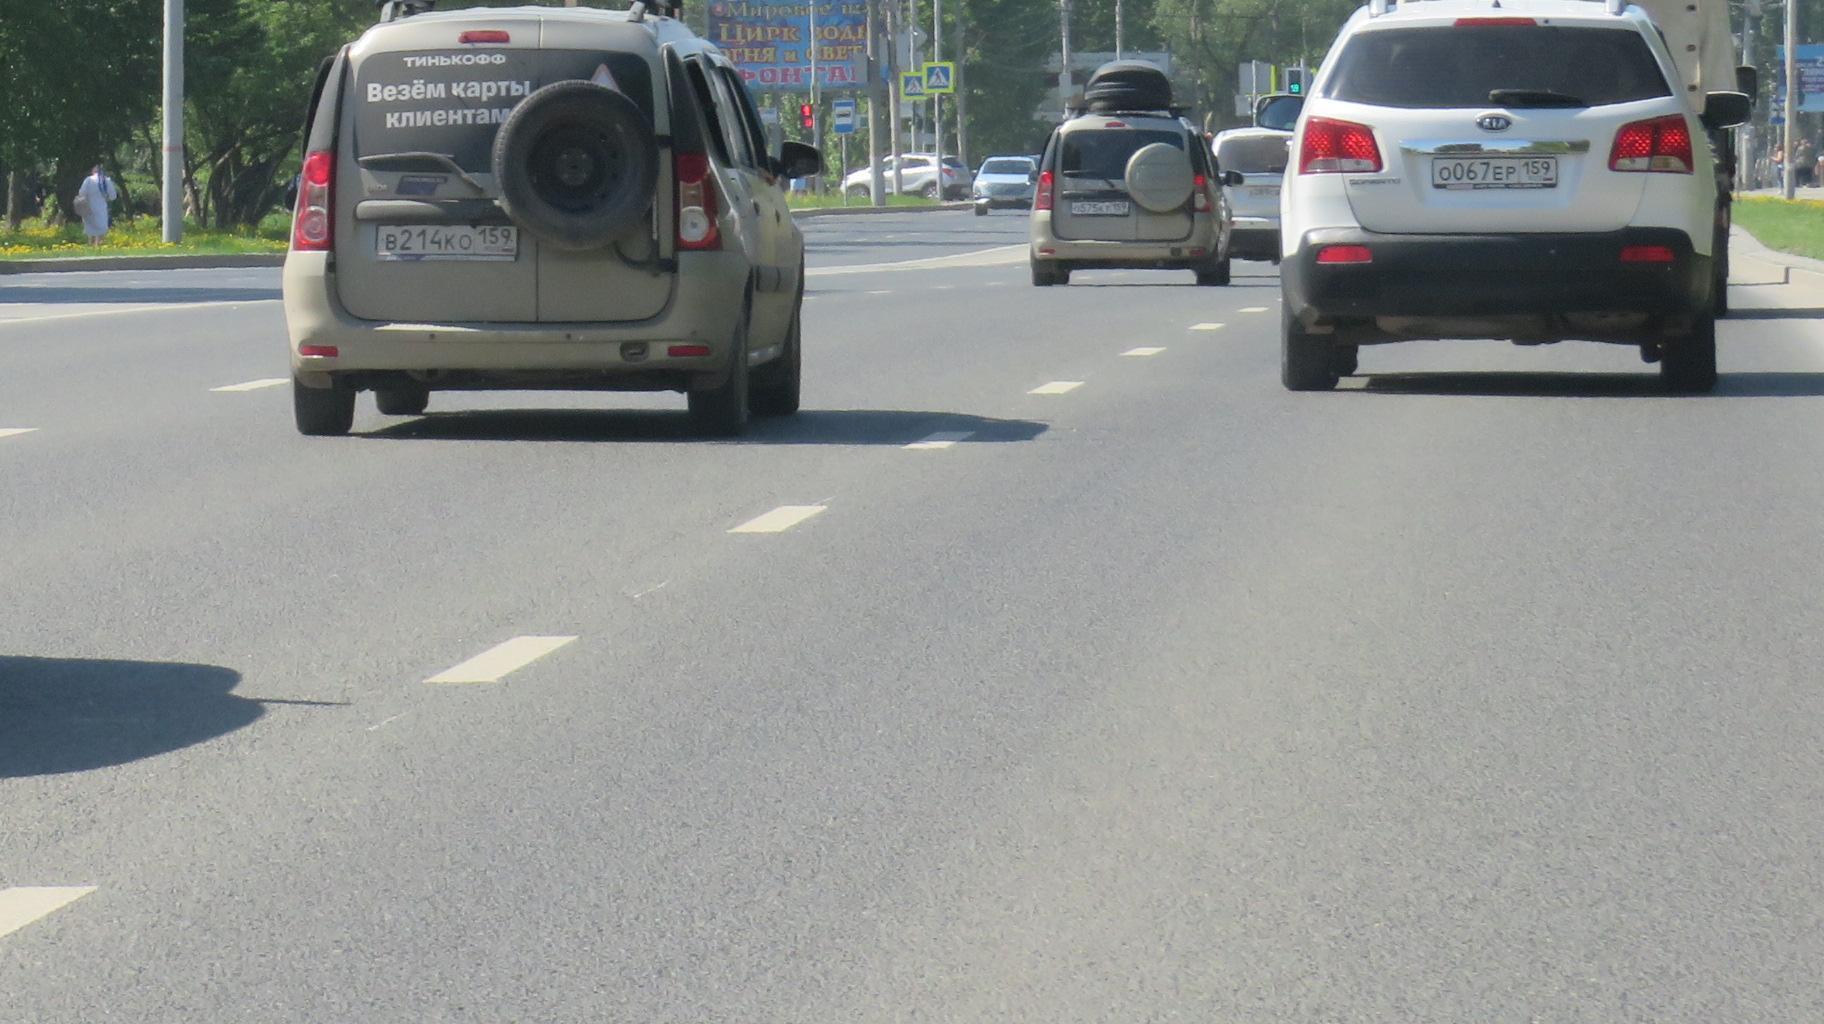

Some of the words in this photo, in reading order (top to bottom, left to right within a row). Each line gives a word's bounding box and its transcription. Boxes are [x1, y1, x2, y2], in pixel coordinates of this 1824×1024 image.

[367, 80, 446, 103] Везём
[451, 81, 530, 102] карты
[386, 107, 511, 129] клиентам
[1523, 161, 1551, 175] 159
[478, 227, 512, 245] 159
